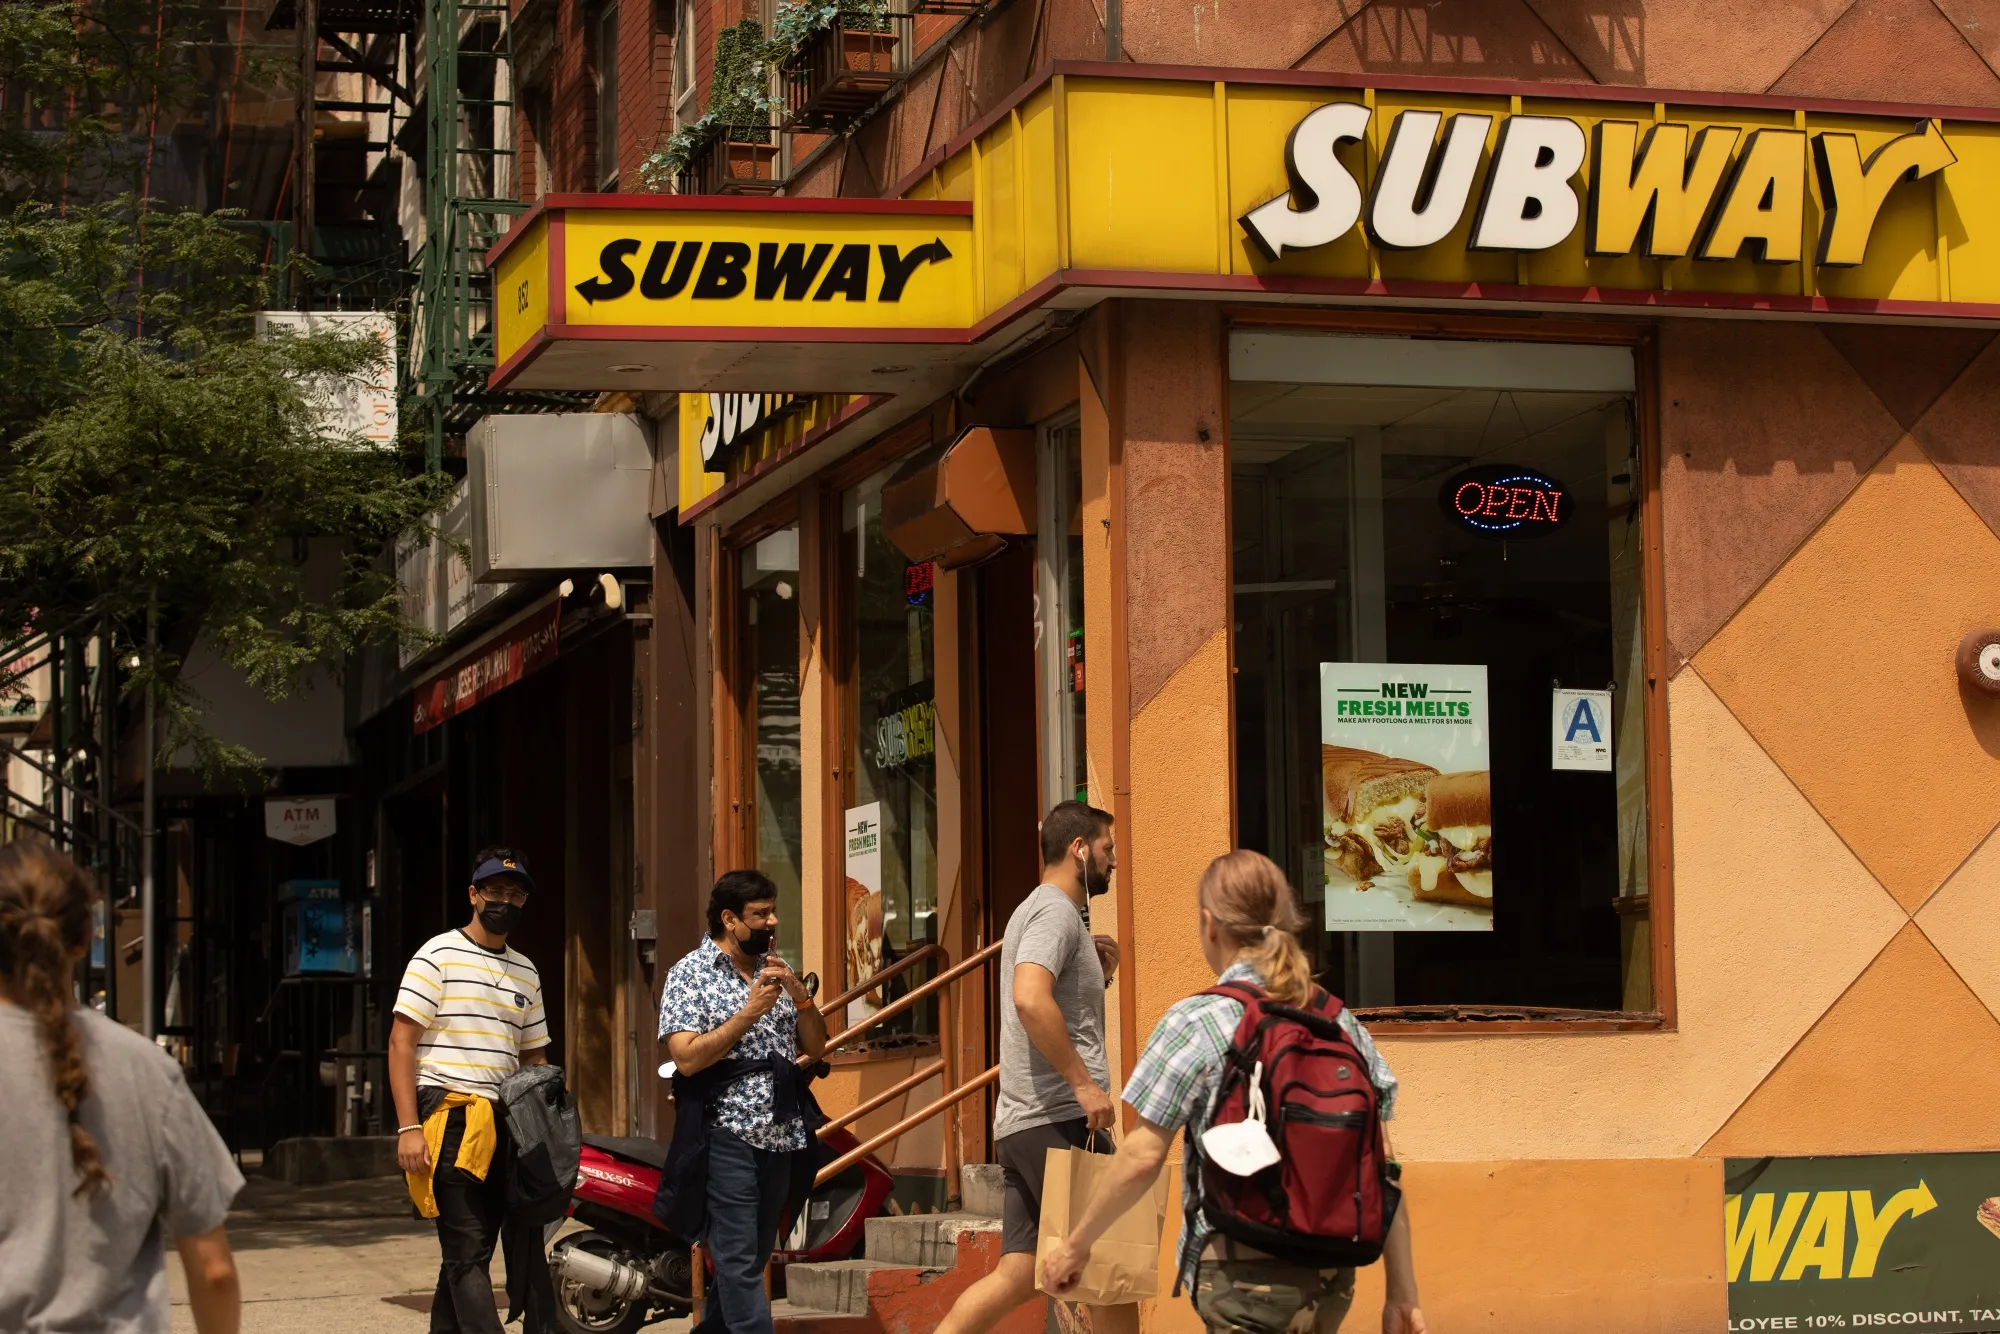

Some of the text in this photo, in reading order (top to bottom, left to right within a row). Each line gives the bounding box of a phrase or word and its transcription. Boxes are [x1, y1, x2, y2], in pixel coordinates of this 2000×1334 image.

[1240, 101, 1958, 267] SUBWAY
[574, 236, 953, 305] SUBWAY
[517, 279, 529, 315] 852
[267, 320, 294, 329] Brown
[1455, 481, 1562, 524] OPEN
[1381, 683, 1429, 699] NEW
[1337, 700, 1402, 716] FRESH
[1564, 699, 1602, 742] A
[284, 807, 320, 821] ATM
[857, 820, 869, 835] NEW
[848, 833, 878, 852] FRESH MELTS
[502, 858, 517, 869] Cal
[308, 887, 340, 899] ATM
[595, 1169, 632, 1187] RX-50
[1805, 1314, 1846, 1329] 10%
[1852, 1310, 1964, 1327] DISCOUNT,
